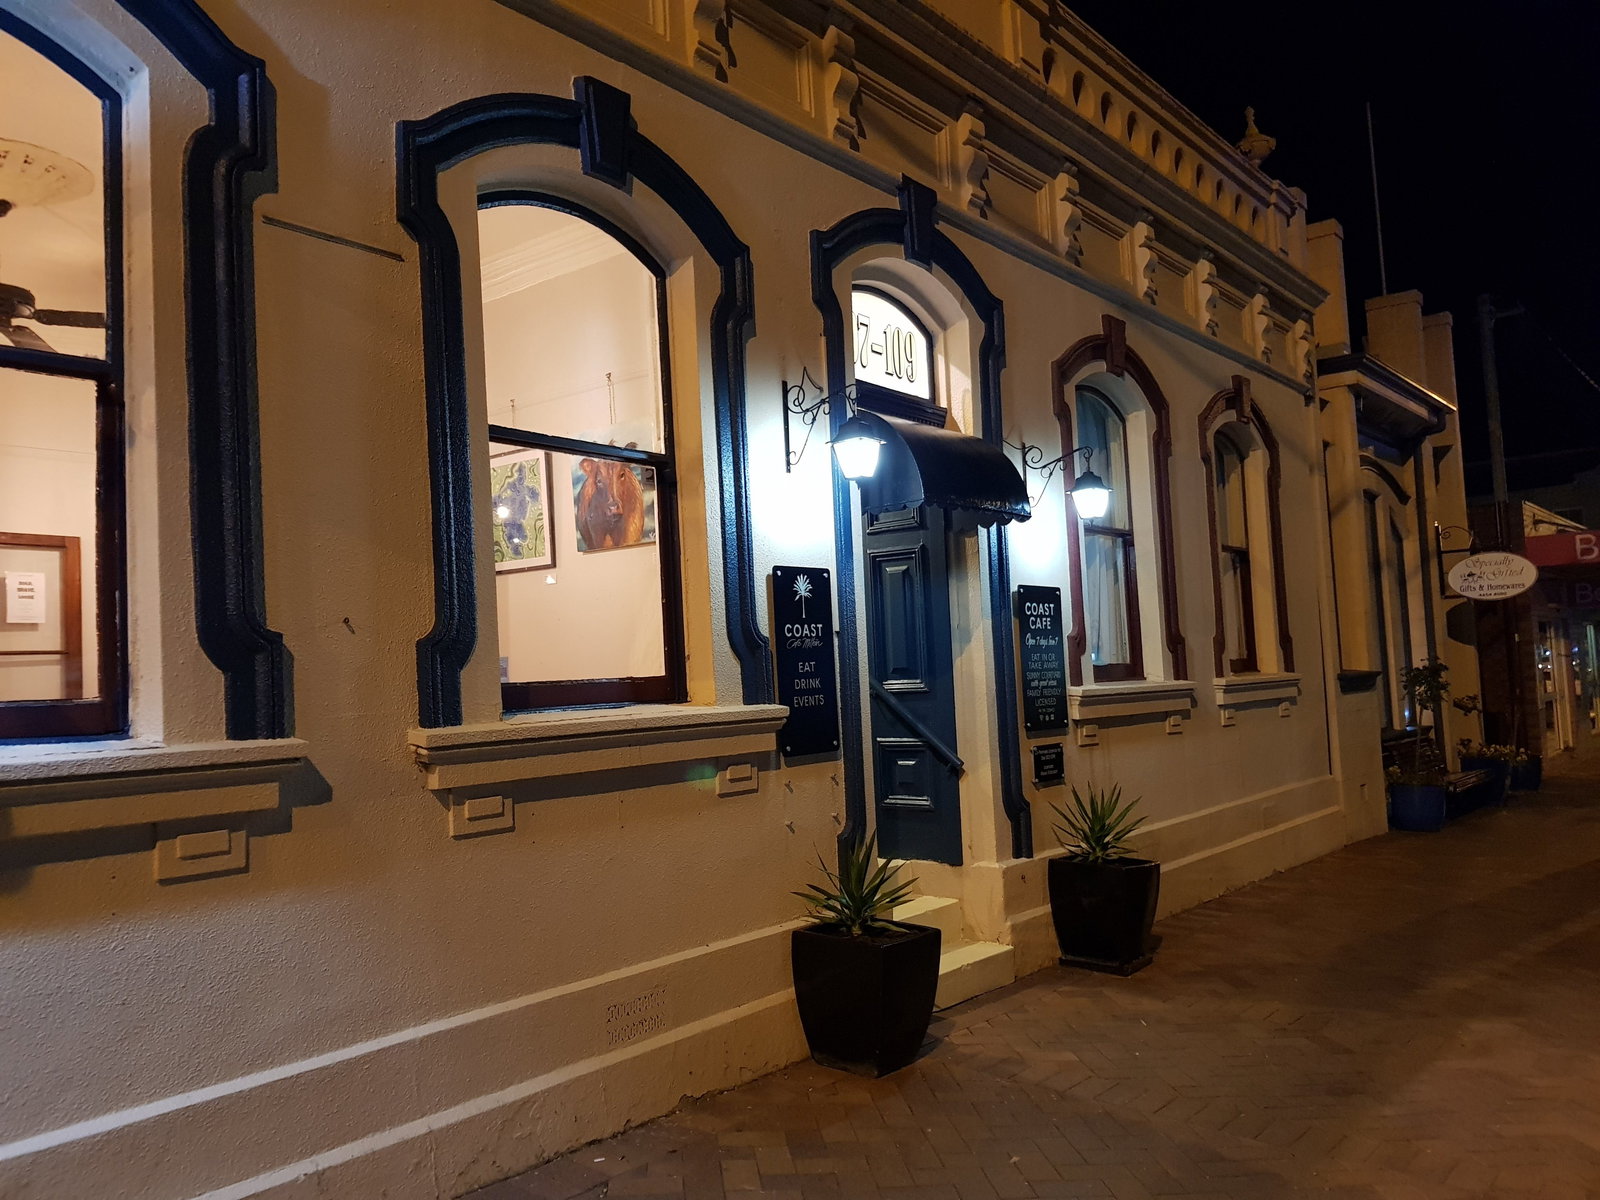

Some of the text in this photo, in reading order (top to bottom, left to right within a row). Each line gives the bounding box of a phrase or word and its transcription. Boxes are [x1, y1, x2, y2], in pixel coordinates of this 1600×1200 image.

[1459, 582, 1525, 593] Gifts & Homewares
[1025, 602, 1054, 616] COAST
[1029, 617, 1051, 629] CAFE
[784, 623, 823, 637] COAST
[1031, 652, 1056, 661] EAT IN OR
[798, 661, 816, 673] EAT
[1028, 660, 1059, 669] TAKE AWAY
[795, 678, 821, 690] DRINK
[1026, 688, 1062, 697] FAMILY FRIENDLY
[794, 695, 825, 707] EVENTS
[1034, 697, 1057, 706] LICENSED
